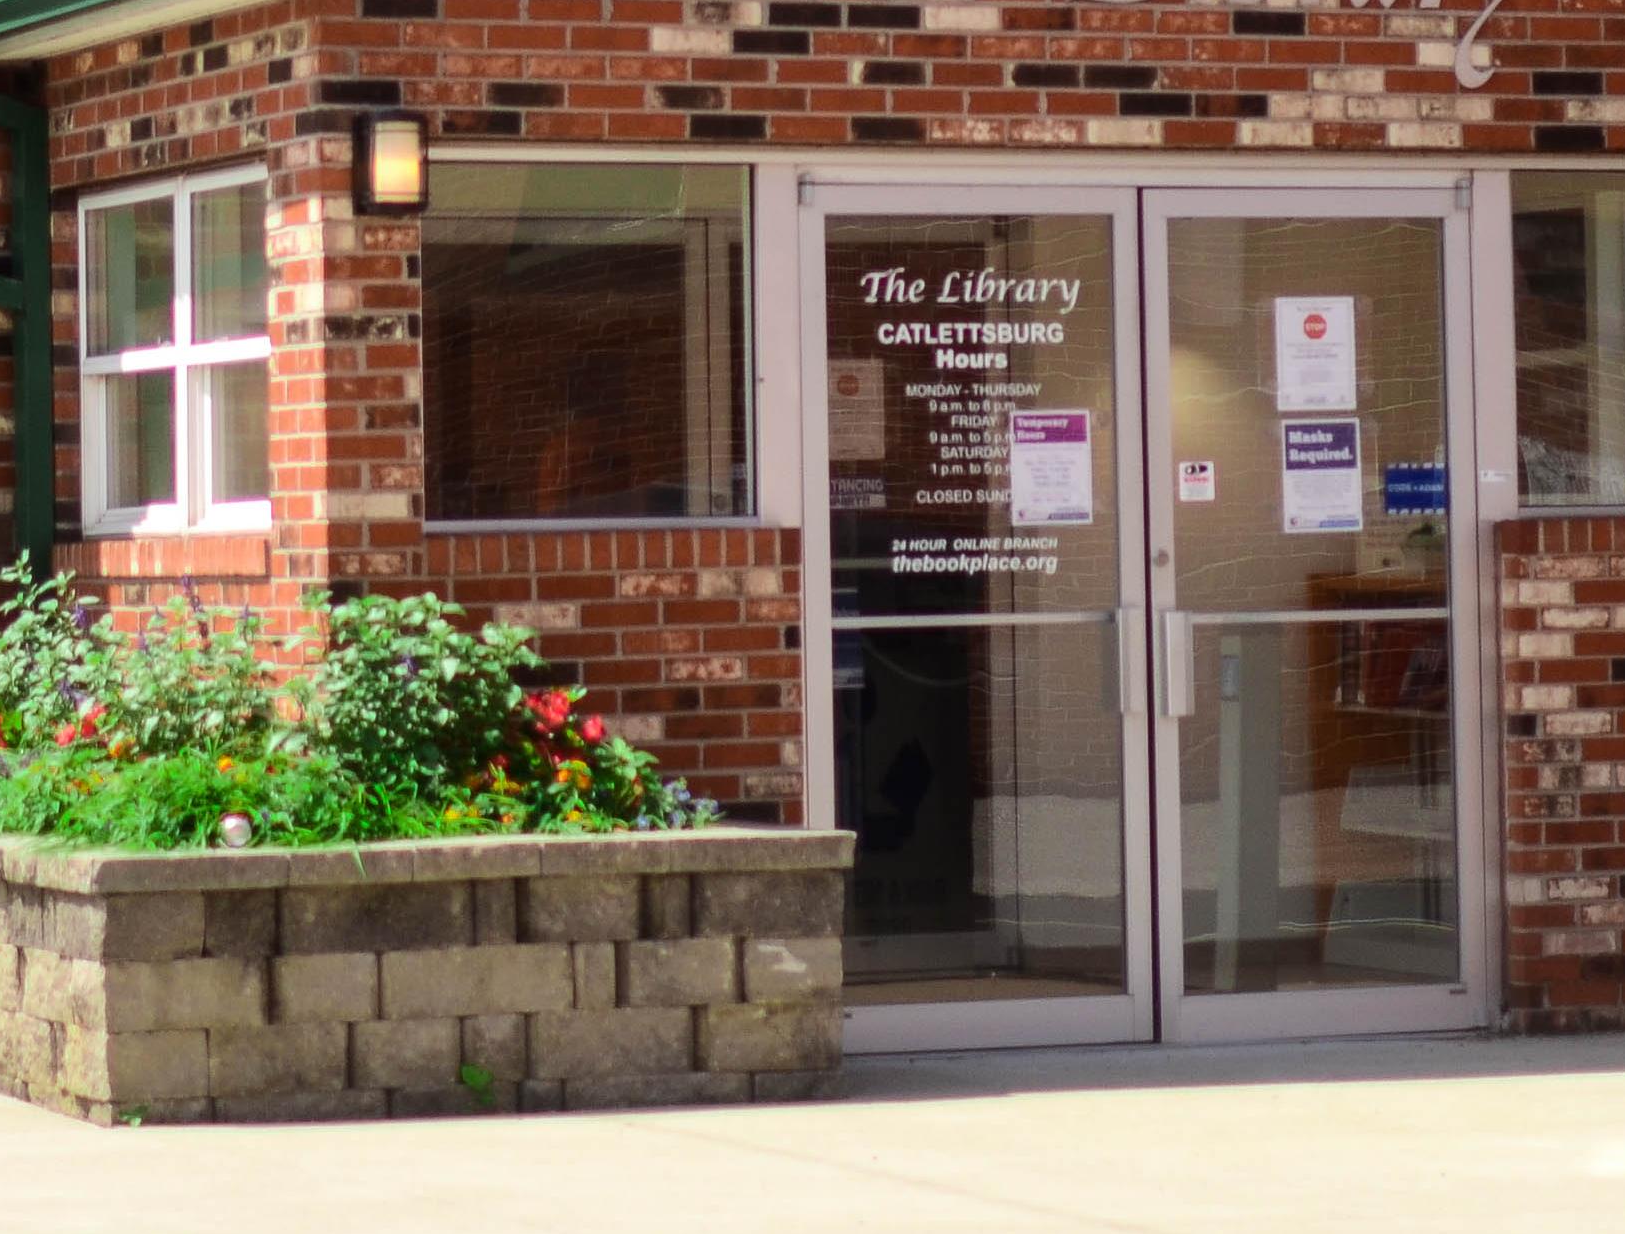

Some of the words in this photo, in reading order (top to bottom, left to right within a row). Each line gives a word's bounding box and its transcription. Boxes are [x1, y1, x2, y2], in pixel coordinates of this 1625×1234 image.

[860, 267, 925, 304] The
[937, 267, 1080, 314] Library
[878, 323, 1064, 344] CATLETTSBURG
[936, 349, 1008, 369] Hours
[906, 384, 962, 397] MONDAY
[973, 383, 1042, 396] THURSDAY
[929, 400, 937, 412] 9
[968, 400, 981, 412] to
[951, 414, 997, 427] FRIDAY
[929, 431, 937, 443] 9
[969, 432, 981, 443] to
[1288, 429, 1334, 444] Masks
[941, 446, 1008, 459] SATURDAY
[1288, 446, 1354, 464] Required.
[969, 463, 981, 474] to
[916, 490, 972, 503] CLOSED
[976, 490, 1012, 503] SUND
[892, 539, 906, 552] 24
[910, 538, 946, 551] HOUR
[953, 537, 1000, 550] ONLINE
[1003, 537, 1058, 550] BRANCH
[892, 553, 1058, 576] thebookplace.org
